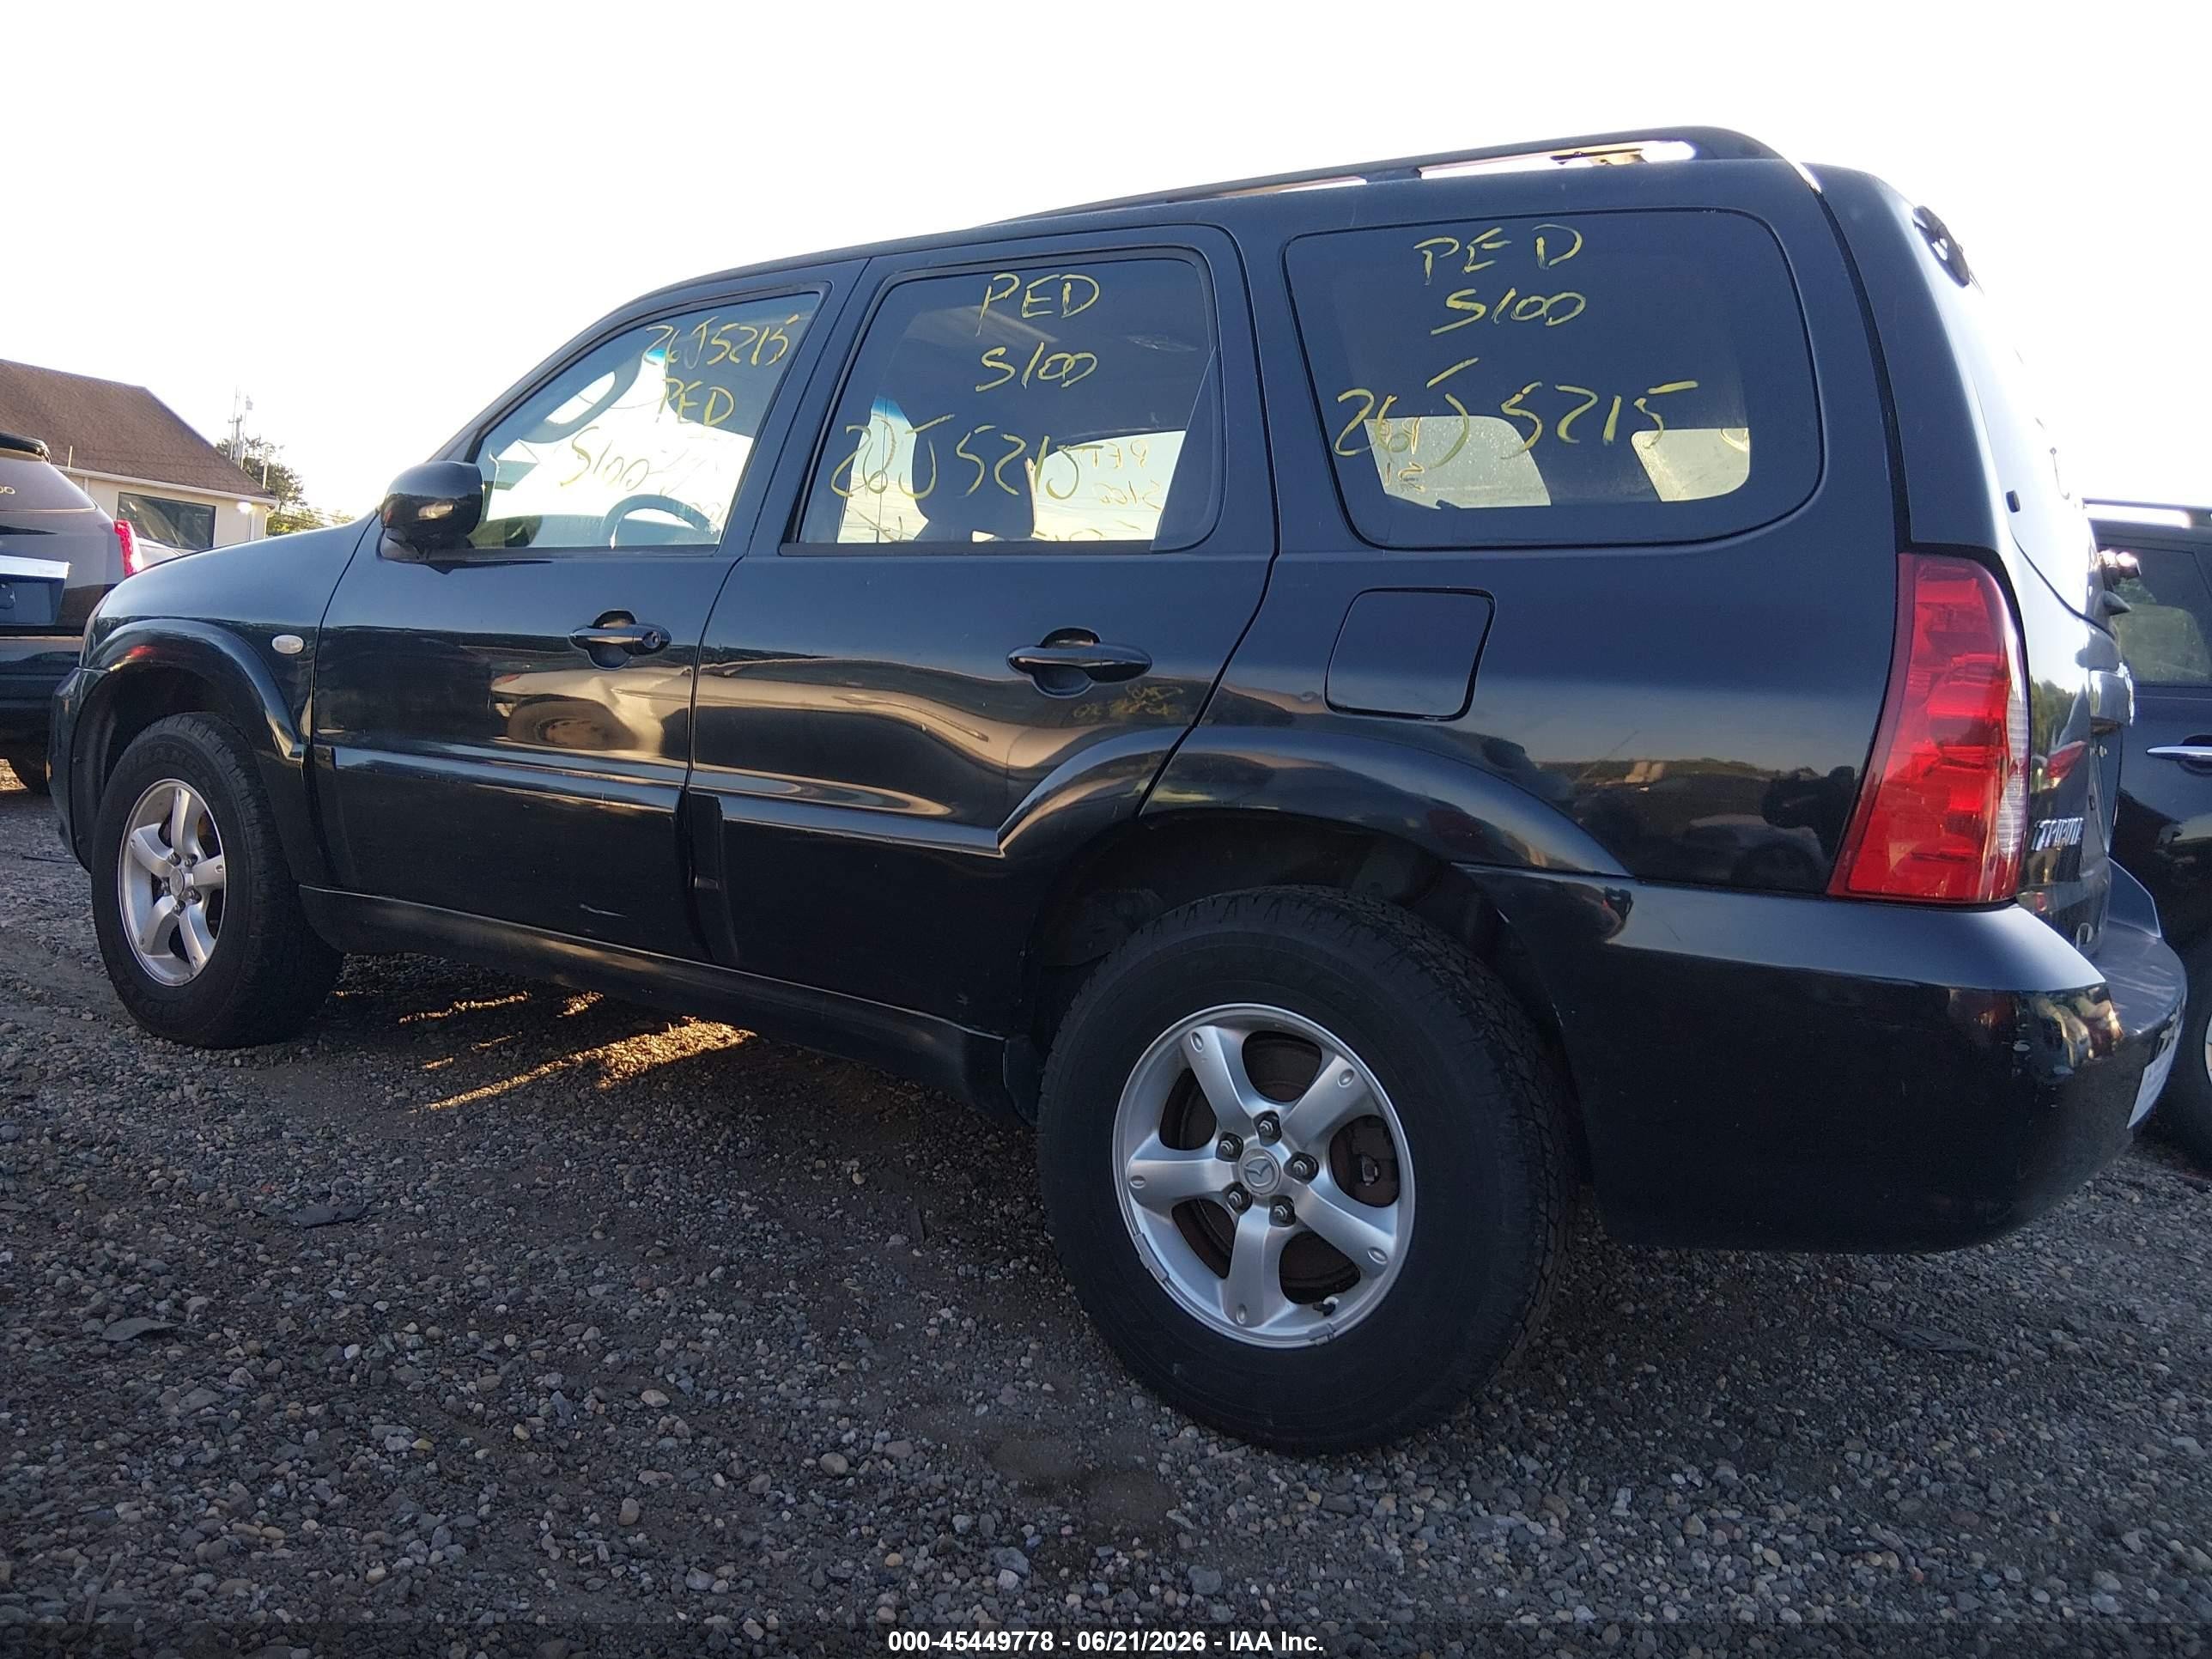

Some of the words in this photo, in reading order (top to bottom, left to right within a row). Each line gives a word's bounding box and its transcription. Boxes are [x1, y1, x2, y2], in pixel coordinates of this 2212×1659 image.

[1413, 224, 1583, 284] PED
[975, 272, 1100, 337] PED
[655, 378, 736, 427] PED
